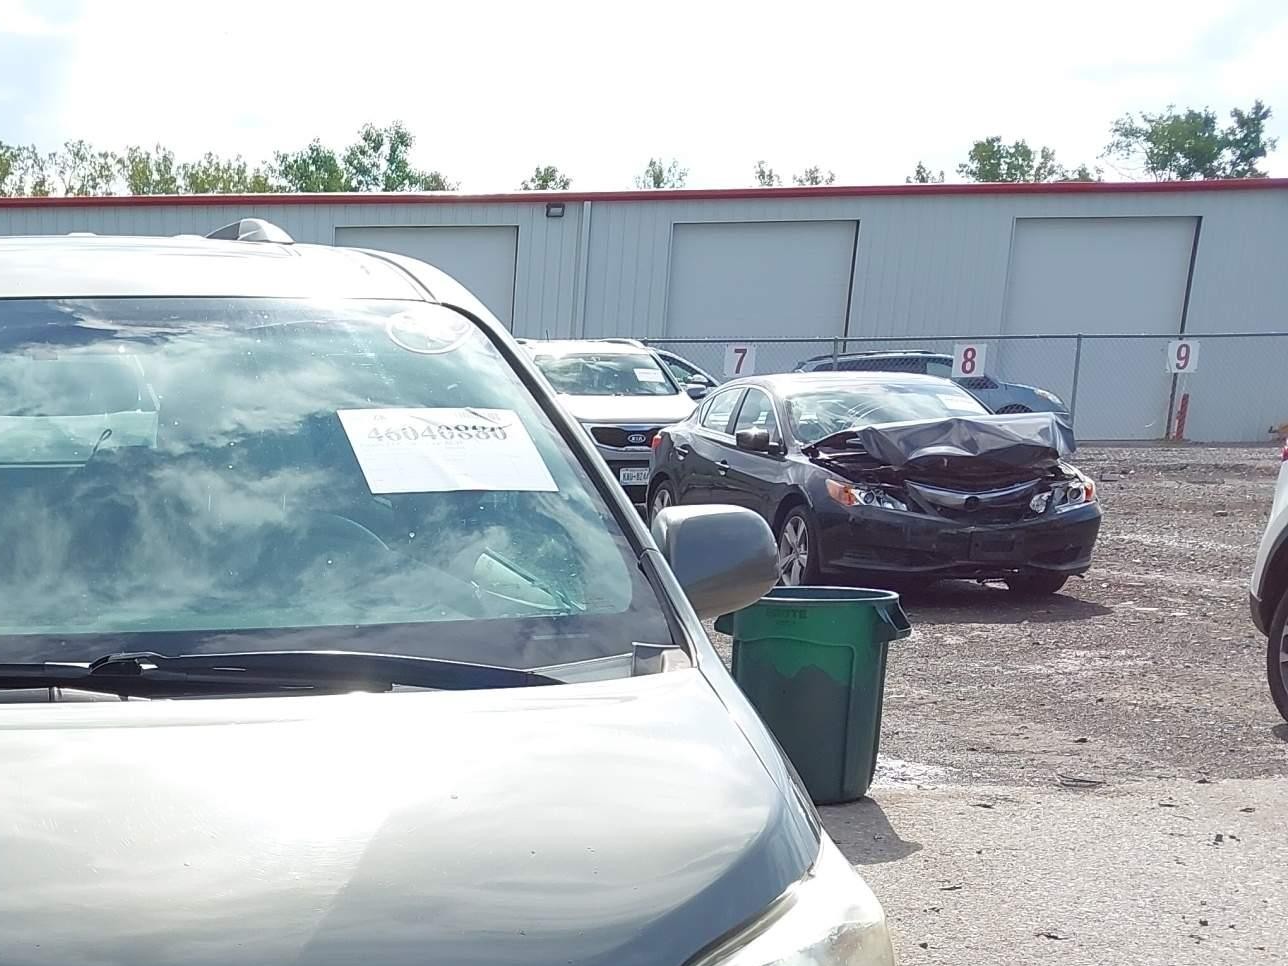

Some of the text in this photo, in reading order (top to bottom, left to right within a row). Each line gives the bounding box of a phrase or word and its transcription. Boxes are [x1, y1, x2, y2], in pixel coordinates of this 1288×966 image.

[733, 348, 748, 374] 7
[960, 348, 976, 374] 8
[1176, 344, 1190, 370] 9
